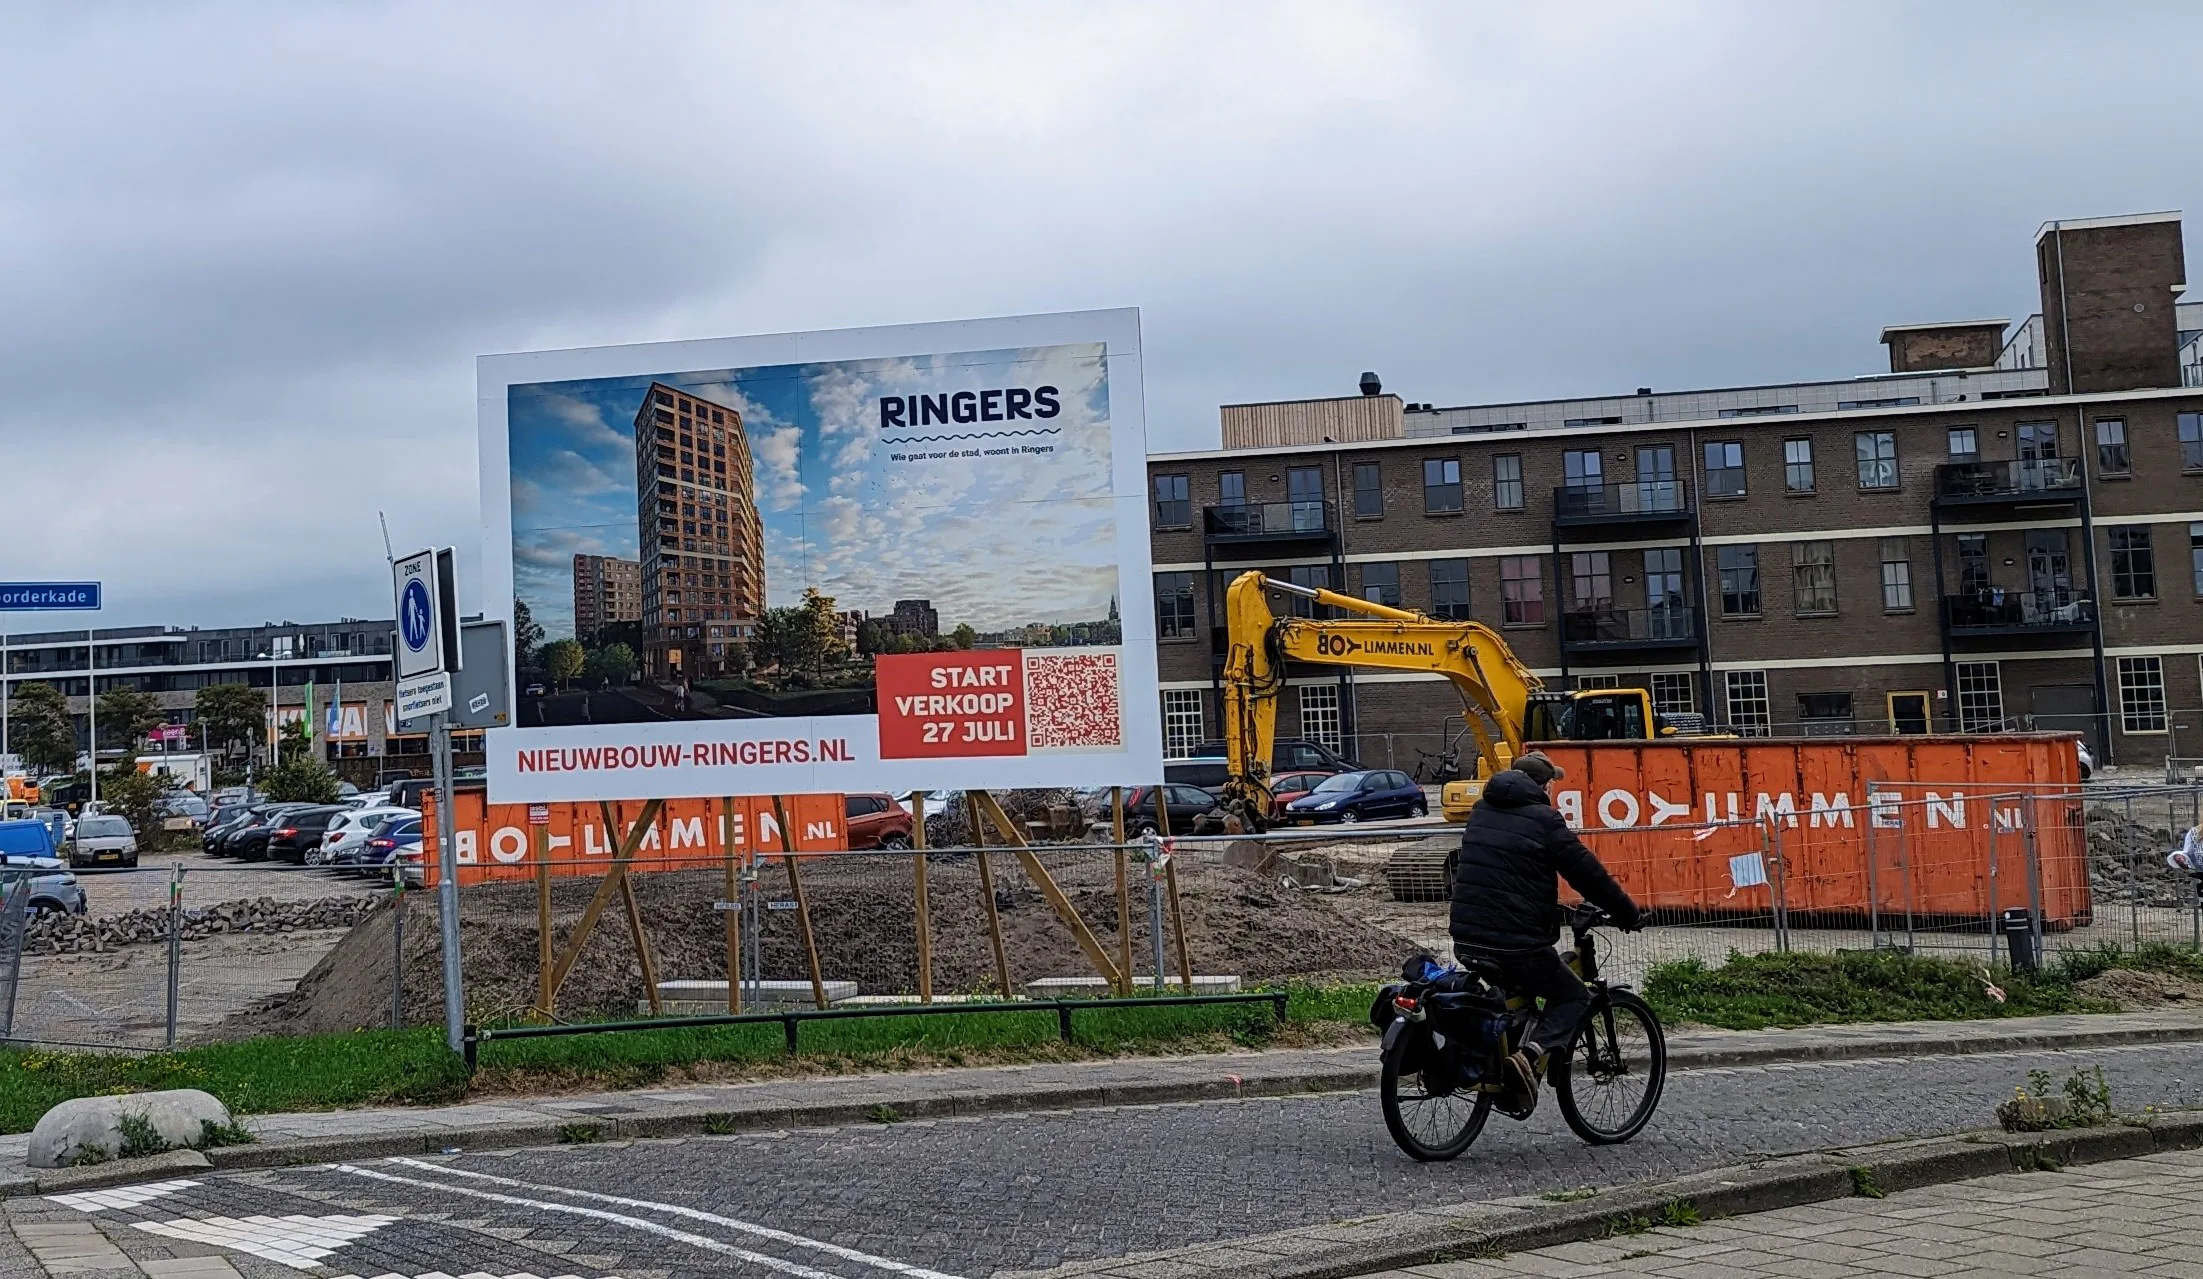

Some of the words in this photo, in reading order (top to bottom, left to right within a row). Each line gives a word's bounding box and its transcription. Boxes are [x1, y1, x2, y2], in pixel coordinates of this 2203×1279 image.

[879, 385, 1061, 428] RINGERS
[890, 453, 907, 462] Wie
[908, 453, 927, 462] gaat
[928, 451, 947, 459] voor
[948, 450, 959, 458] de
[961, 448, 982, 458] stad,
[983, 447, 1010, 456] woont
[1011, 446, 1020, 454] in
[1021, 445, 1054, 455] Ringers
[404, 560, 422, 576] ZONE
[0, 589, 87, 604] orderkade
[1316, 634, 1362, 656] BOY
[1364, 640, 1435, 656] LIMMEN.NL
[931, 665, 1013, 688] START
[895, 693, 1014, 717] VERKOOP
[922, 722, 955, 743] 27
[961, 720, 1015, 742] JULI
[518, 739, 856, 773] NIEUWBOUW-RINGERS.NL
[1557, 789, 1690, 829] BOY
[1705, 791, 1967, 829] LIMMEN
[803, 821, 837, 841] .NL
